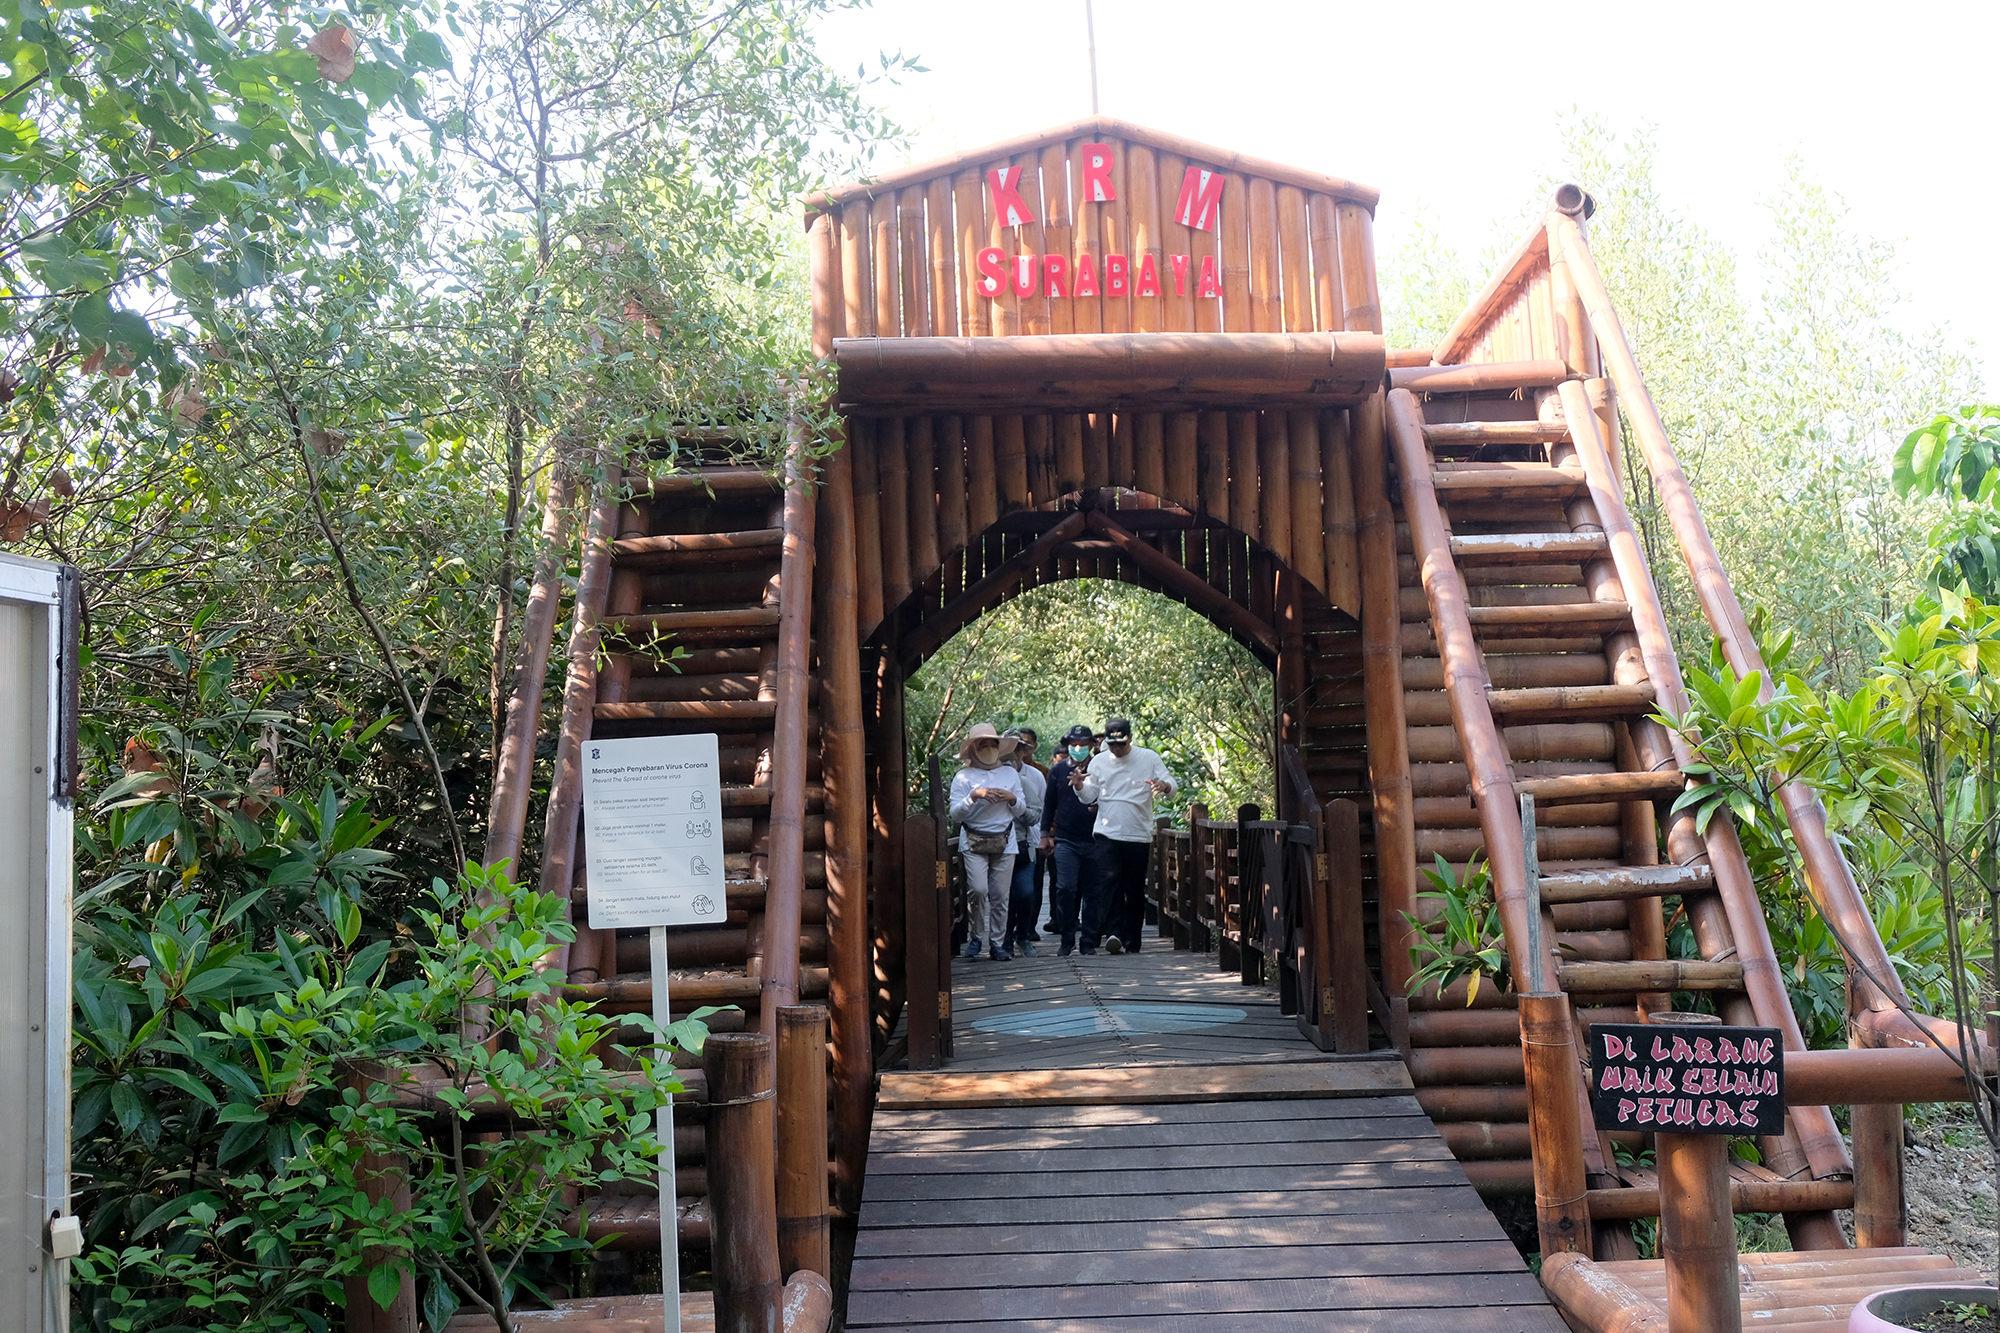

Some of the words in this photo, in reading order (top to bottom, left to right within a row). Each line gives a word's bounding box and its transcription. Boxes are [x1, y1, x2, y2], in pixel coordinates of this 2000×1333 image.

[976, 247, 1224, 298] SURABAYA
[592, 767, 625, 775] Mencegah
[627, 764, 664, 774] Penyebaran
